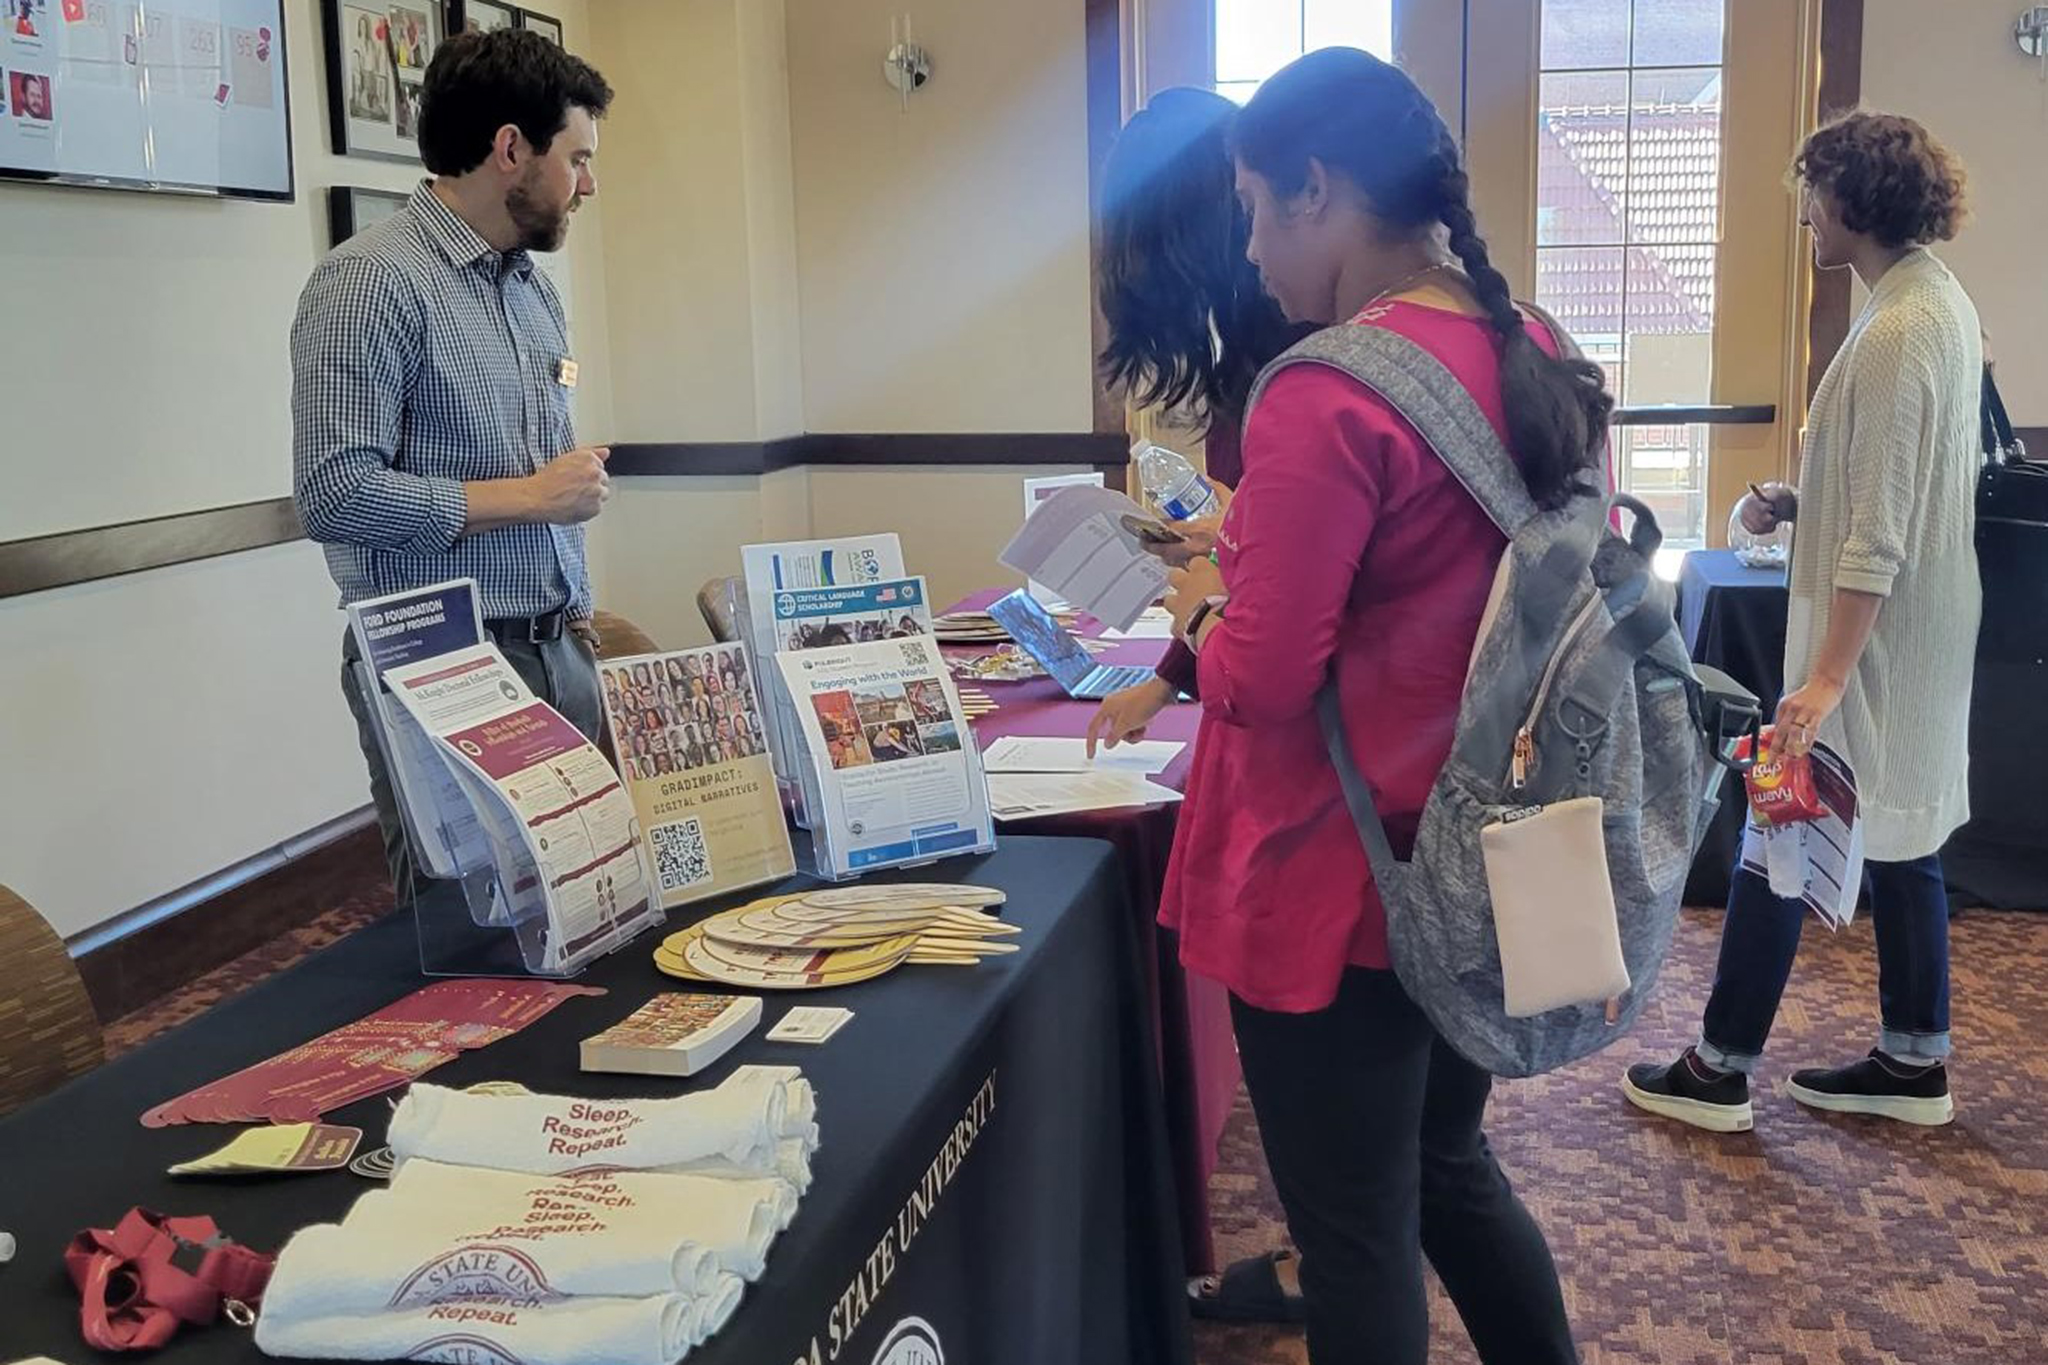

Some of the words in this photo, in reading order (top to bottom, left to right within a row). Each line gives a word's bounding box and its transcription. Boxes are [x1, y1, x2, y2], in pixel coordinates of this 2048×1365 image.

[797, 593, 828, 604] CRITICAL
[828, 590, 865, 601] LANGUAGE
[363, 613, 384, 630] FORD
[384, 599, 444, 624] FOUNDATION
[367, 622, 406, 641] FELLOWSHIP
[406, 612, 446, 631] PROGRAMS
[811, 677, 857, 690] Engaging
[858, 673, 881, 684] with
[882, 671, 897, 681] the
[897, 667, 928, 679] World
[660, 768, 743, 797] GRADIMPACT:
[653, 797, 696, 815] DIGITAL
[700, 781, 760, 803] NARRATIVES
[568, 1103, 633, 1122] Sleep.
[548, 1133, 628, 1158] Repeat.
[523, 1211, 597, 1224] Sleep.
[828, 1226, 897, 1361] STATE
[897, 1068, 997, 1252] UNIVERSITY
[428, 1252, 499, 1289] STATE
[428, 1304, 518, 1326] Repeat.
